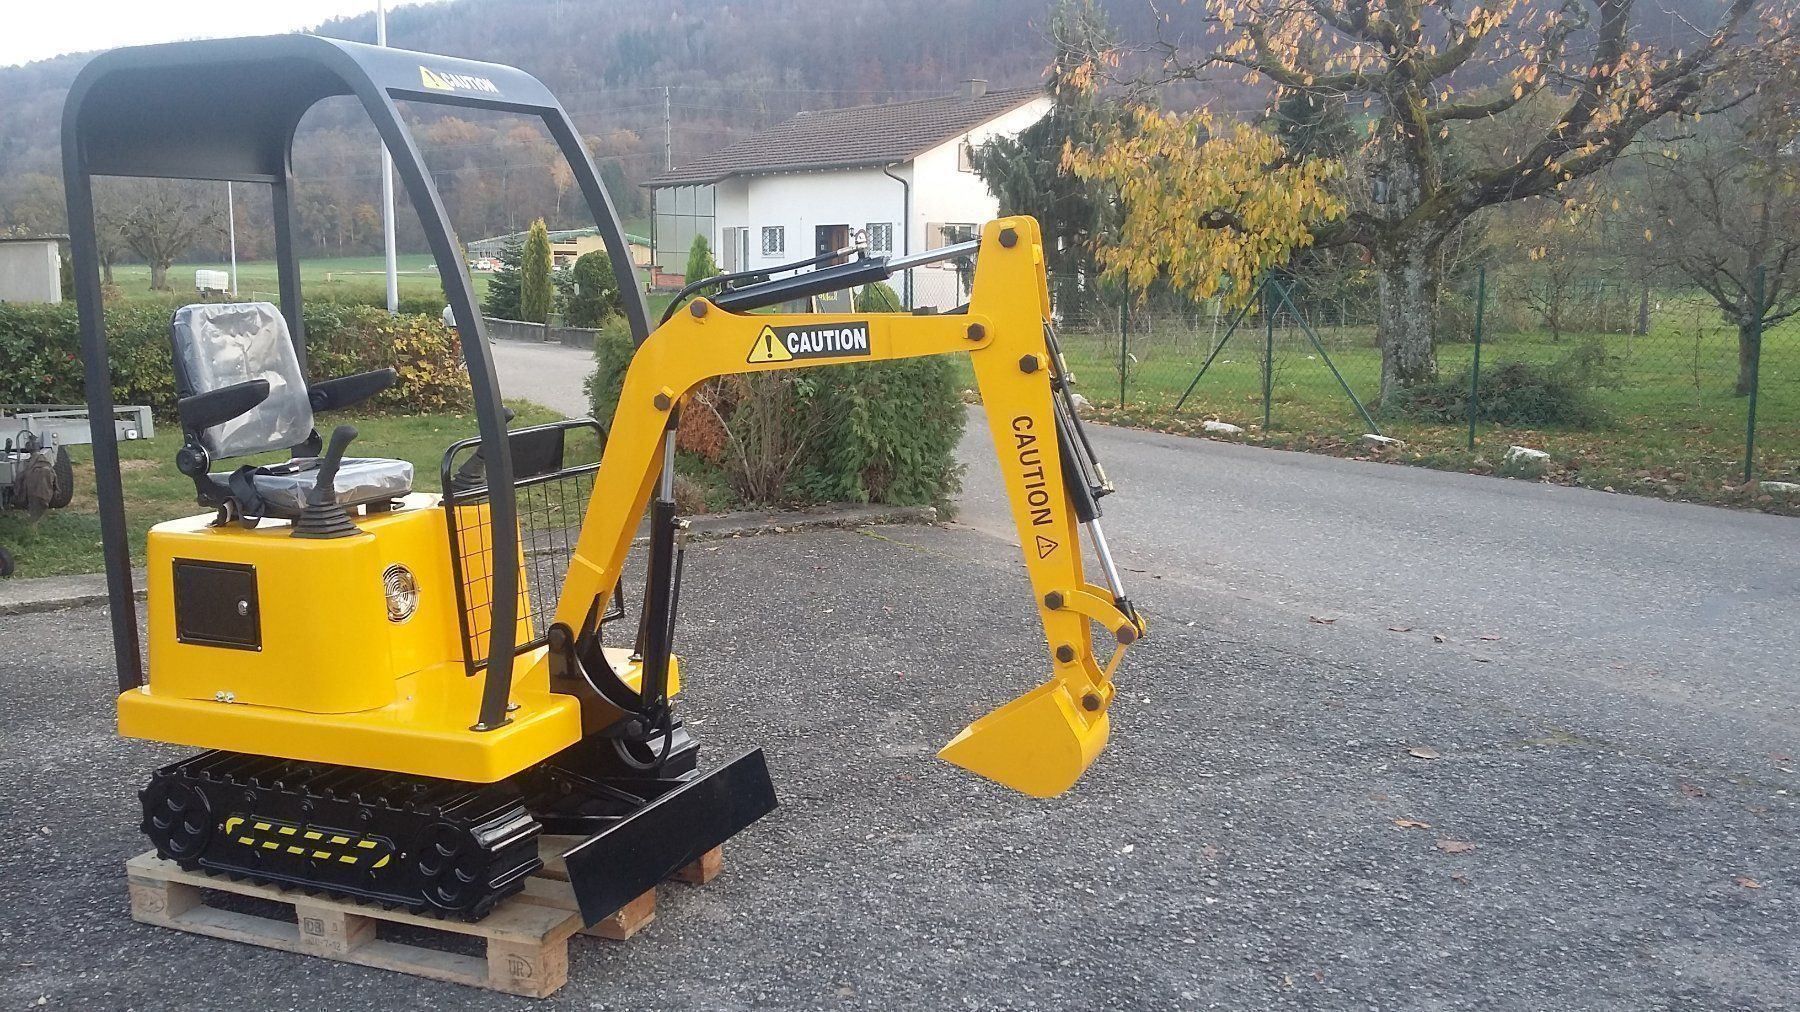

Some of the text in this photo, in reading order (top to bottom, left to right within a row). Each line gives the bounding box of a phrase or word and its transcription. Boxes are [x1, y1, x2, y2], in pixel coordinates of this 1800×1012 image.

[440, 72, 500, 93] CAUTION
[786, 327, 867, 354] CAUTION
[1011, 415, 1053, 526] CAUTION
